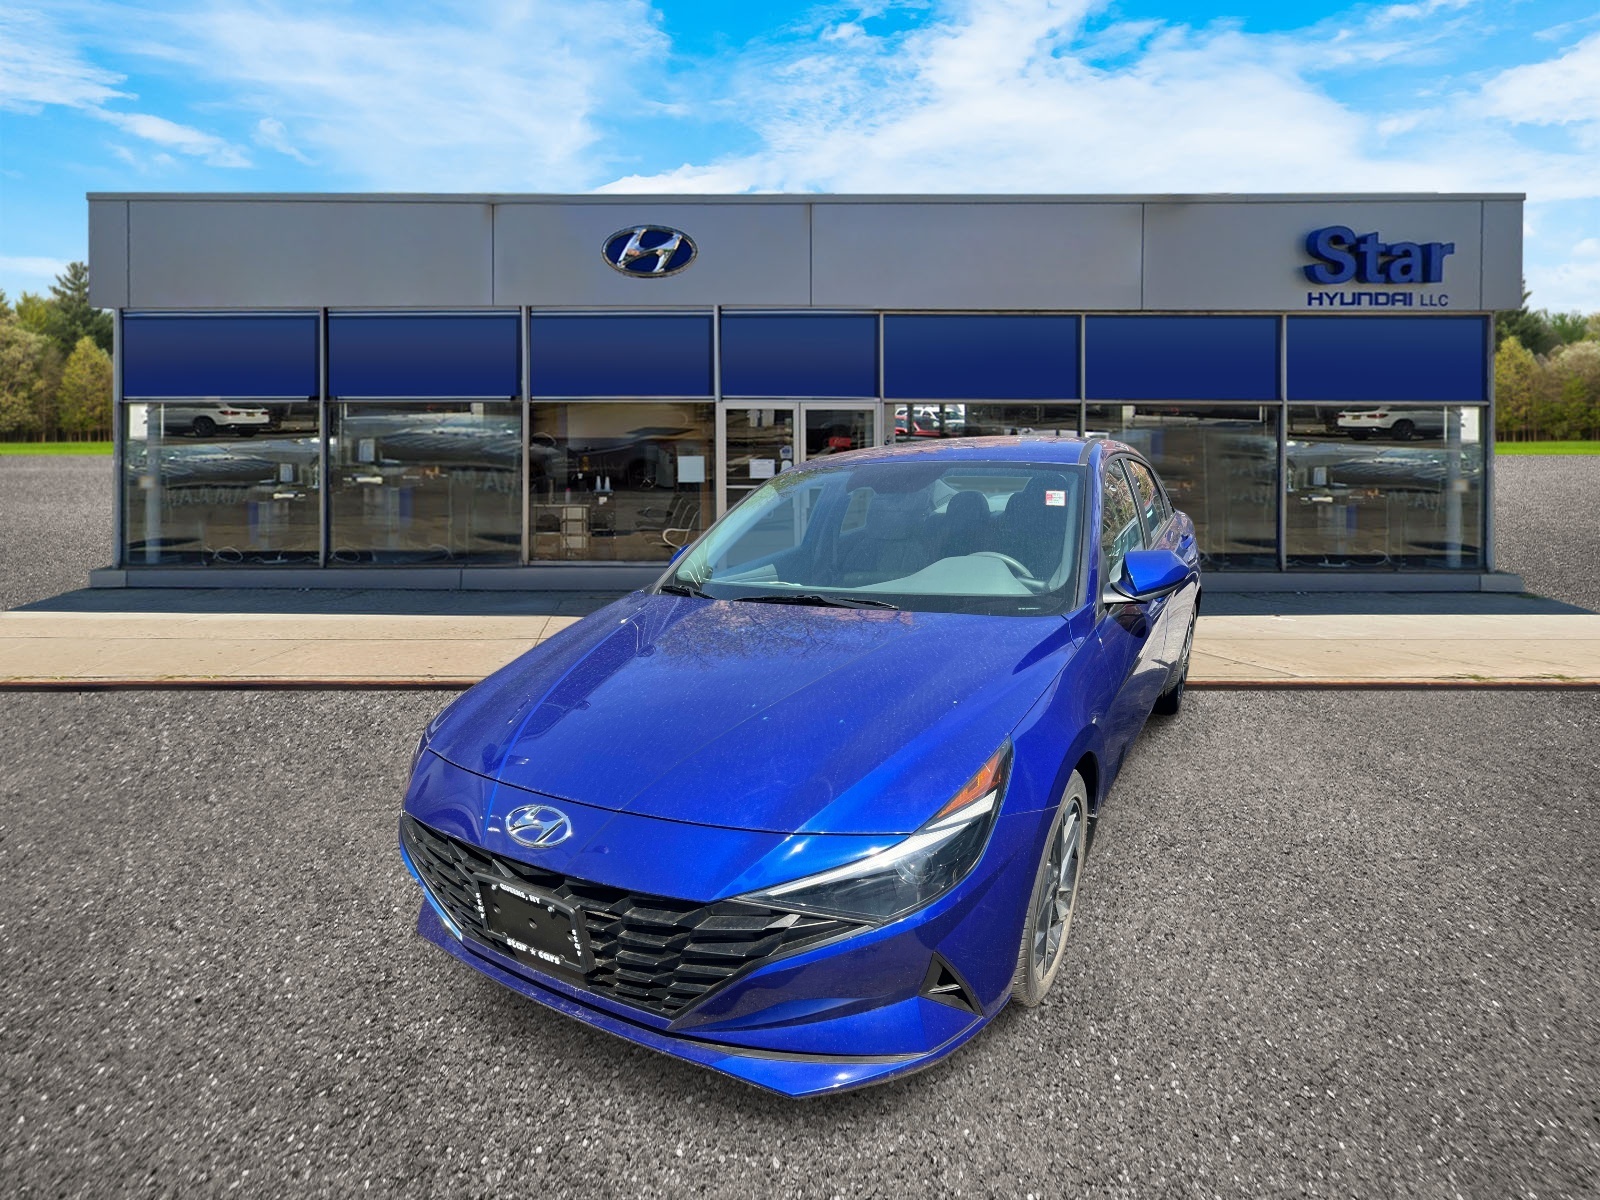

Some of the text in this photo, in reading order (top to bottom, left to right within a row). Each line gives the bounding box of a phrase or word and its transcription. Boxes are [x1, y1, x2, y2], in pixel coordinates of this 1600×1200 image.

[1303, 225, 1455, 285] Star
[1307, 292, 1449, 307] HYUNDAI LLC
